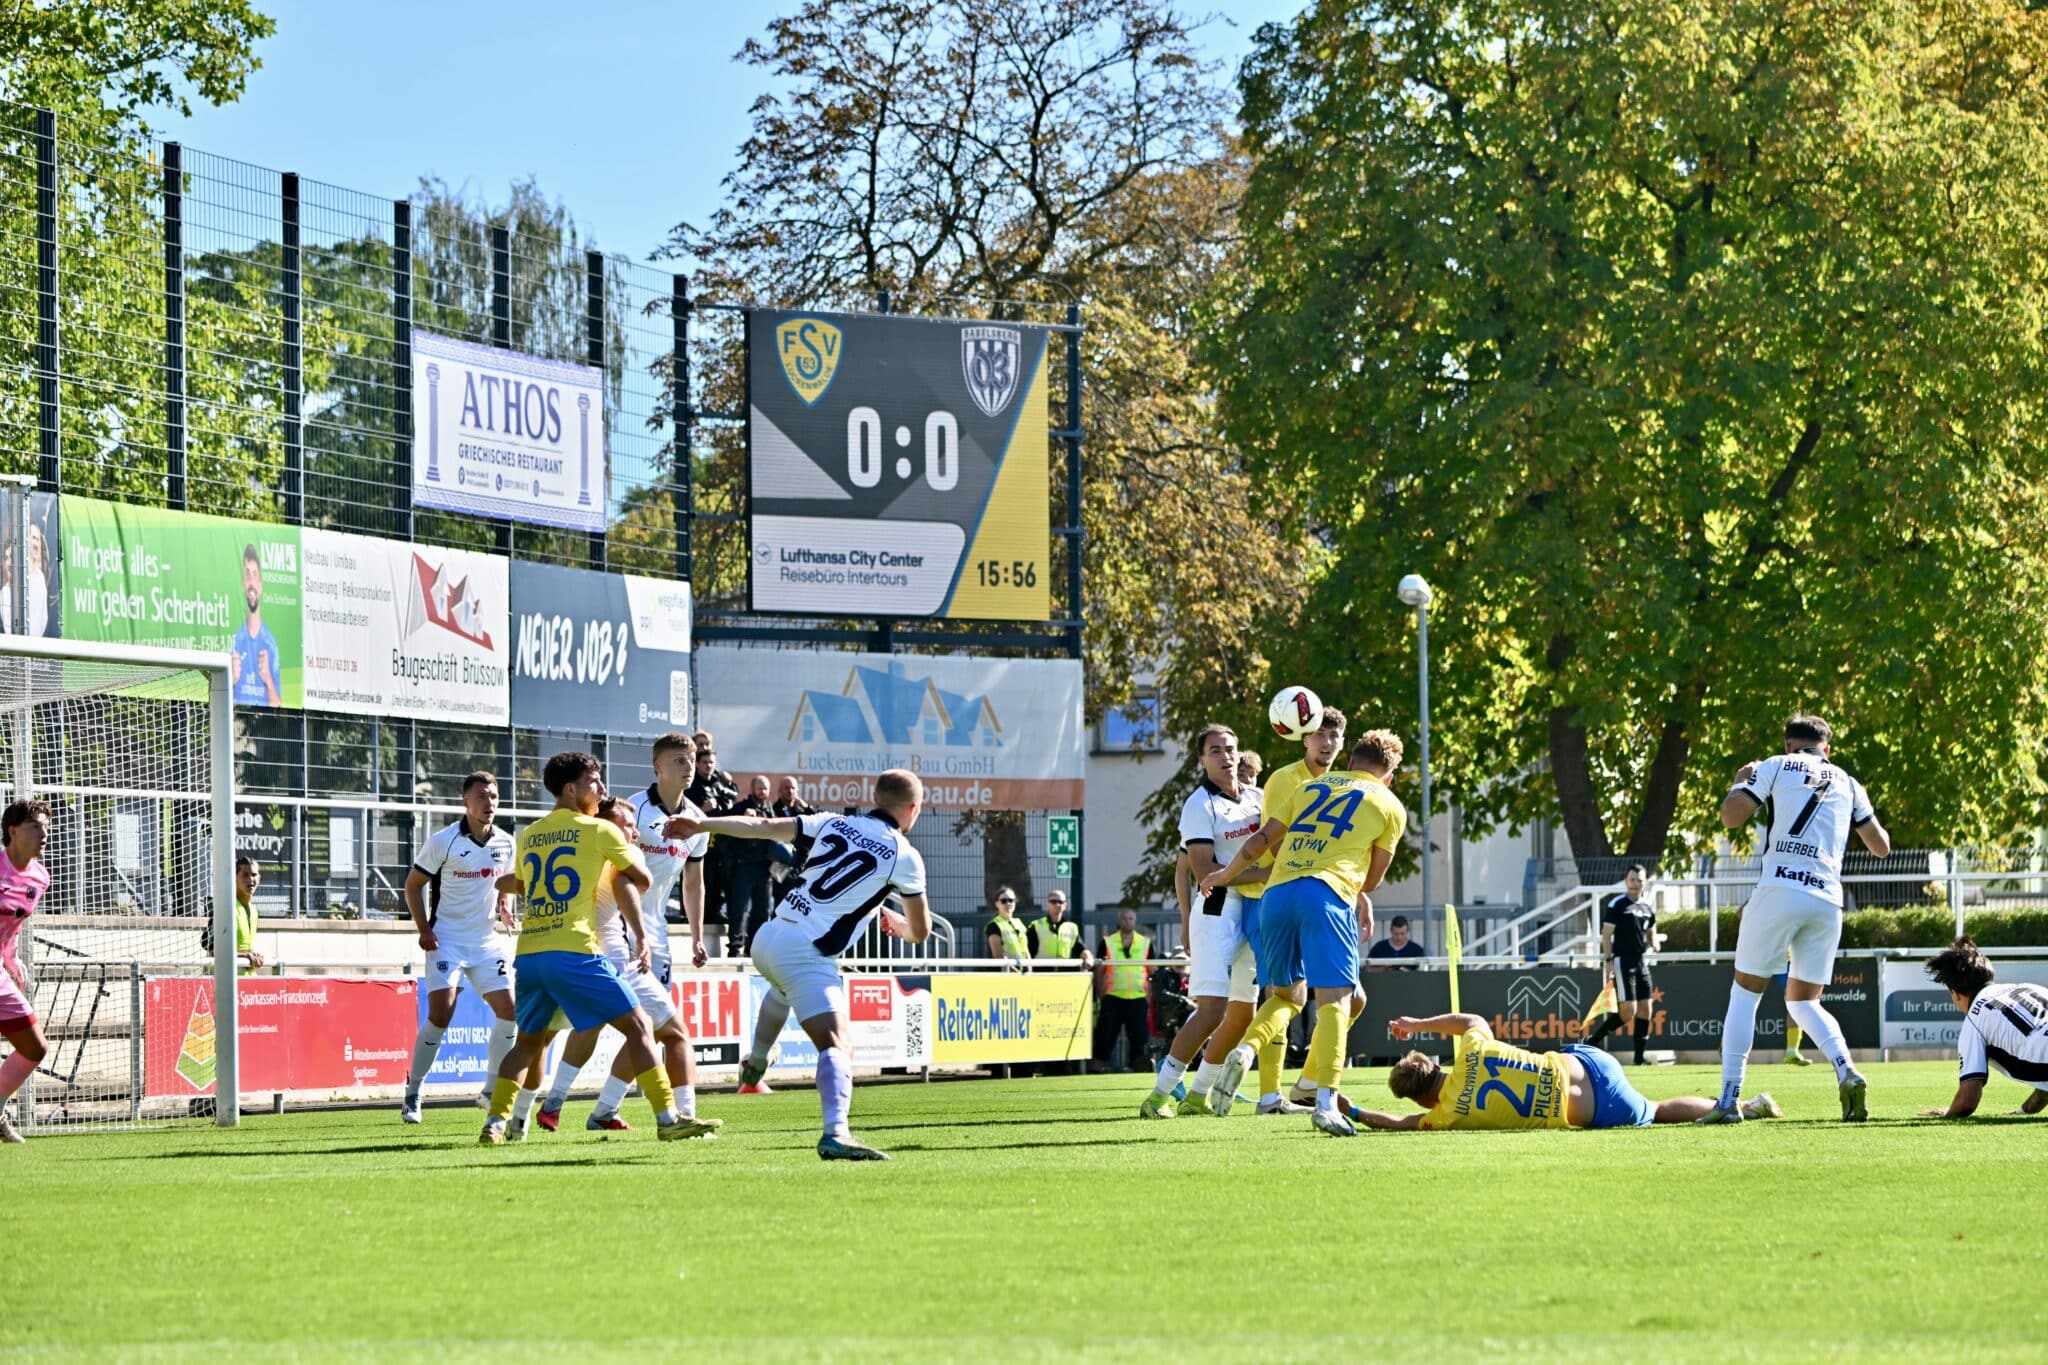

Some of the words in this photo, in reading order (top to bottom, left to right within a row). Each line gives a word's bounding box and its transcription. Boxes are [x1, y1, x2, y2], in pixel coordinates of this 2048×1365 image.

[964, 329, 1018, 342] BABELSBERG
[784, 323, 838, 379] FSV
[802, 357, 817, 370] 63
[973, 350, 1012, 392] 03
[460, 371, 562, 443] ATHOS
[459, 443, 516, 468] GRIECHISCHES
[517, 453, 563, 475] RESTAURANT
[848, 406, 959, 491] 0:0
[71, 536, 89, 569] Ihr
[94, 544, 124, 580] gebt
[131, 545, 158, 578] alles
[260, 541, 285, 570] LVM
[304, 550, 329, 567] Neubau
[334, 553, 357, 570] Umbau
[780, 547, 847, 566] Lufthansa
[850, 550, 883, 570] City
[883, 551, 924, 568] Center
[305, 576, 339, 600] Sanierung
[342, 581, 392, 602] Rekonstruktion
[780, 567, 845, 584] Reisebüro
[847, 569, 908, 587] Intertours
[977, 561, 1036, 588] 15:56
[74, 578, 97, 614] wir
[101, 584, 146, 626] geben
[151, 587, 230, 628] Sicherheit!
[305, 604, 369, 627] Trockenbauarbeiten
[516, 612, 574, 681] NEUER
[392, 648, 458, 686] Baugeschäft
[463, 656, 504, 687] Brüssow
[797, 751, 906, 770] Luckenwalder
[911, 754, 941, 773] Bau
[944, 754, 995, 775] GmbH
[235, 807, 264, 829] erbe
[1288, 783, 1365, 840] 24
[1788, 774, 1831, 839] 7
[831, 820, 896, 861] BABELSBERG
[453, 870, 481, 878] Potsdam
[523, 845, 581, 906] 26
[803, 833, 878, 905] 20
[1775, 865, 1825, 889] Katjes
[785, 890, 812, 917] atjes
[495, 959, 507, 976] 2
[1834, 973, 1864, 985] Hotel
[240, 985, 329, 1008] Sparkassen-Finanzkonzept.
[1903, 1000, 1921, 1012] Ihr
[938, 997, 1031, 1041] Reifen-Müller
[1901, 1026, 1936, 1042] Tel.:
[1454, 1050, 1480, 1116] LUCKENWALDE
[1476, 1056, 1539, 1118] 21
[1534, 1067, 1553, 1118] PILGER
